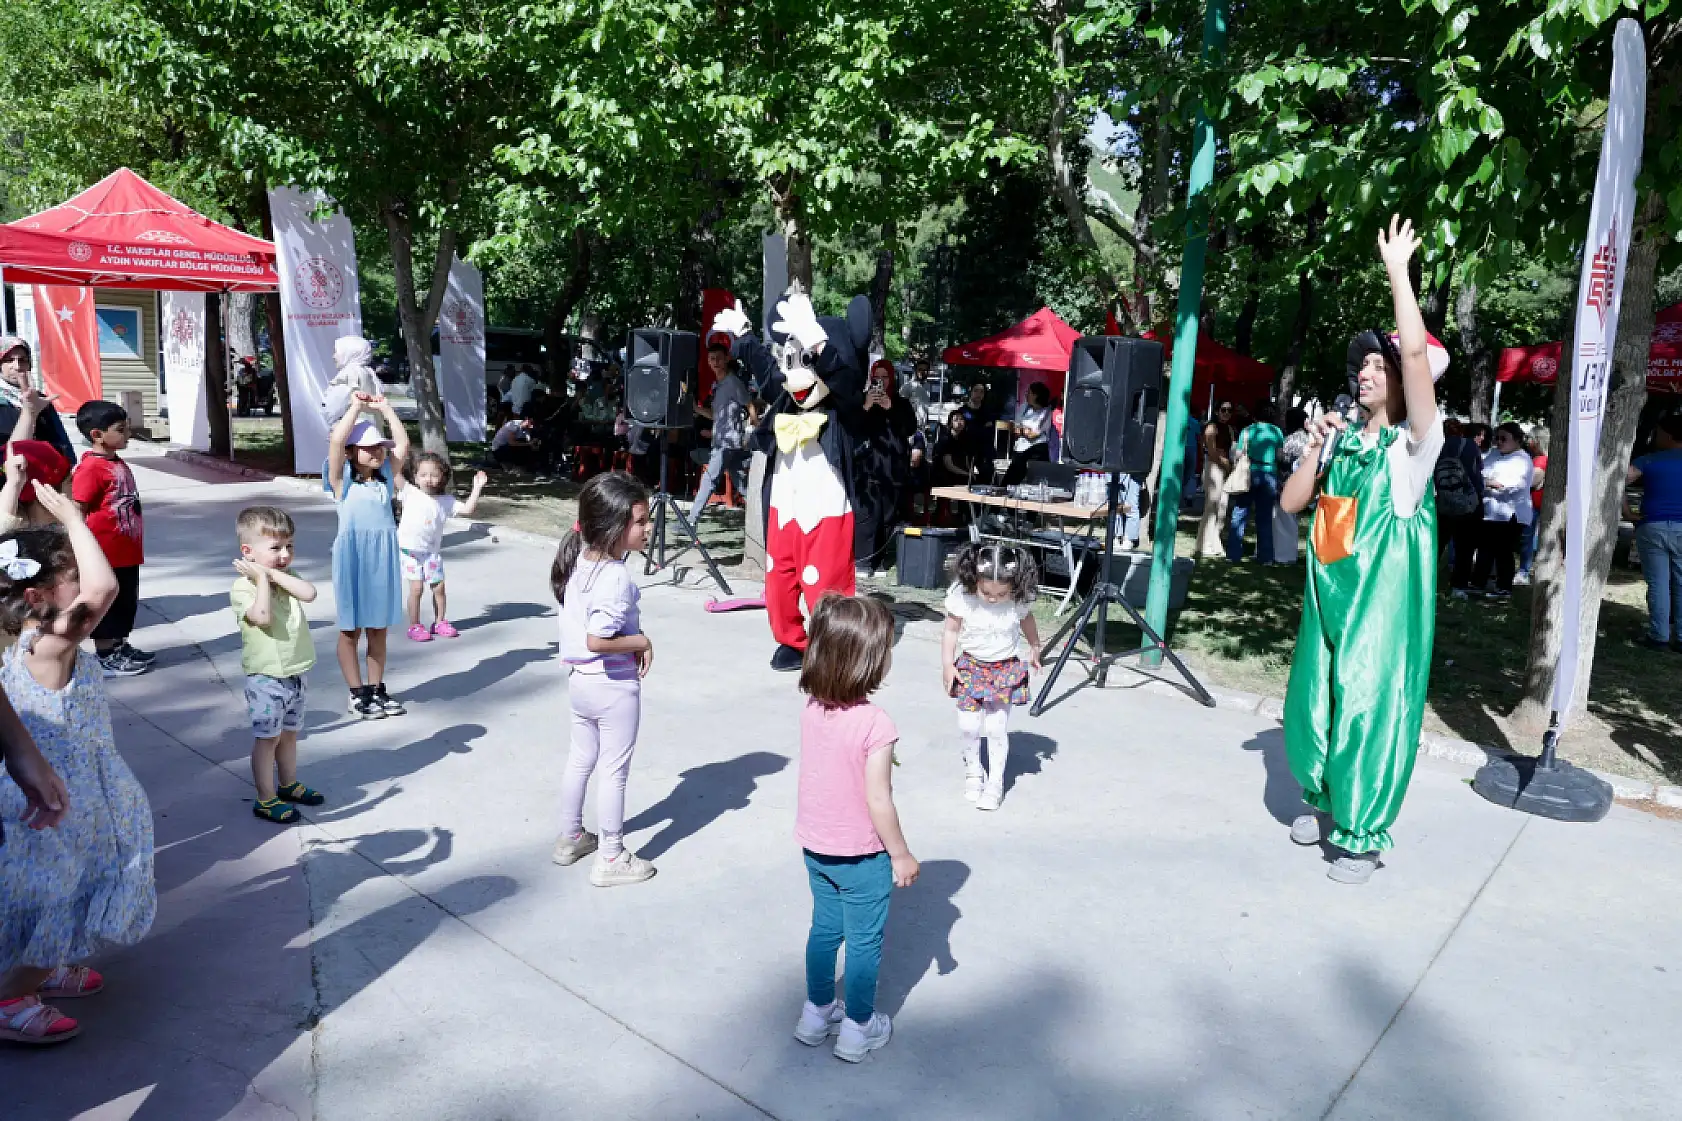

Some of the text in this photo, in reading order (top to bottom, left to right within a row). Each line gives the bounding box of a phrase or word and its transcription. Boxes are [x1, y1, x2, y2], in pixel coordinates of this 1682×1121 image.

[108, 244, 124, 254] T.C.
[126, 246, 171, 257] VAKIFLAR
[173, 249, 201, 260] GENEL
[100, 255, 130, 266] AYDIN
[132, 258, 178, 269] VAKIFLAR
[180, 259, 209, 271] BÖLGE
[211, 262, 264, 275] MÜDÜRLÜĞÜ
